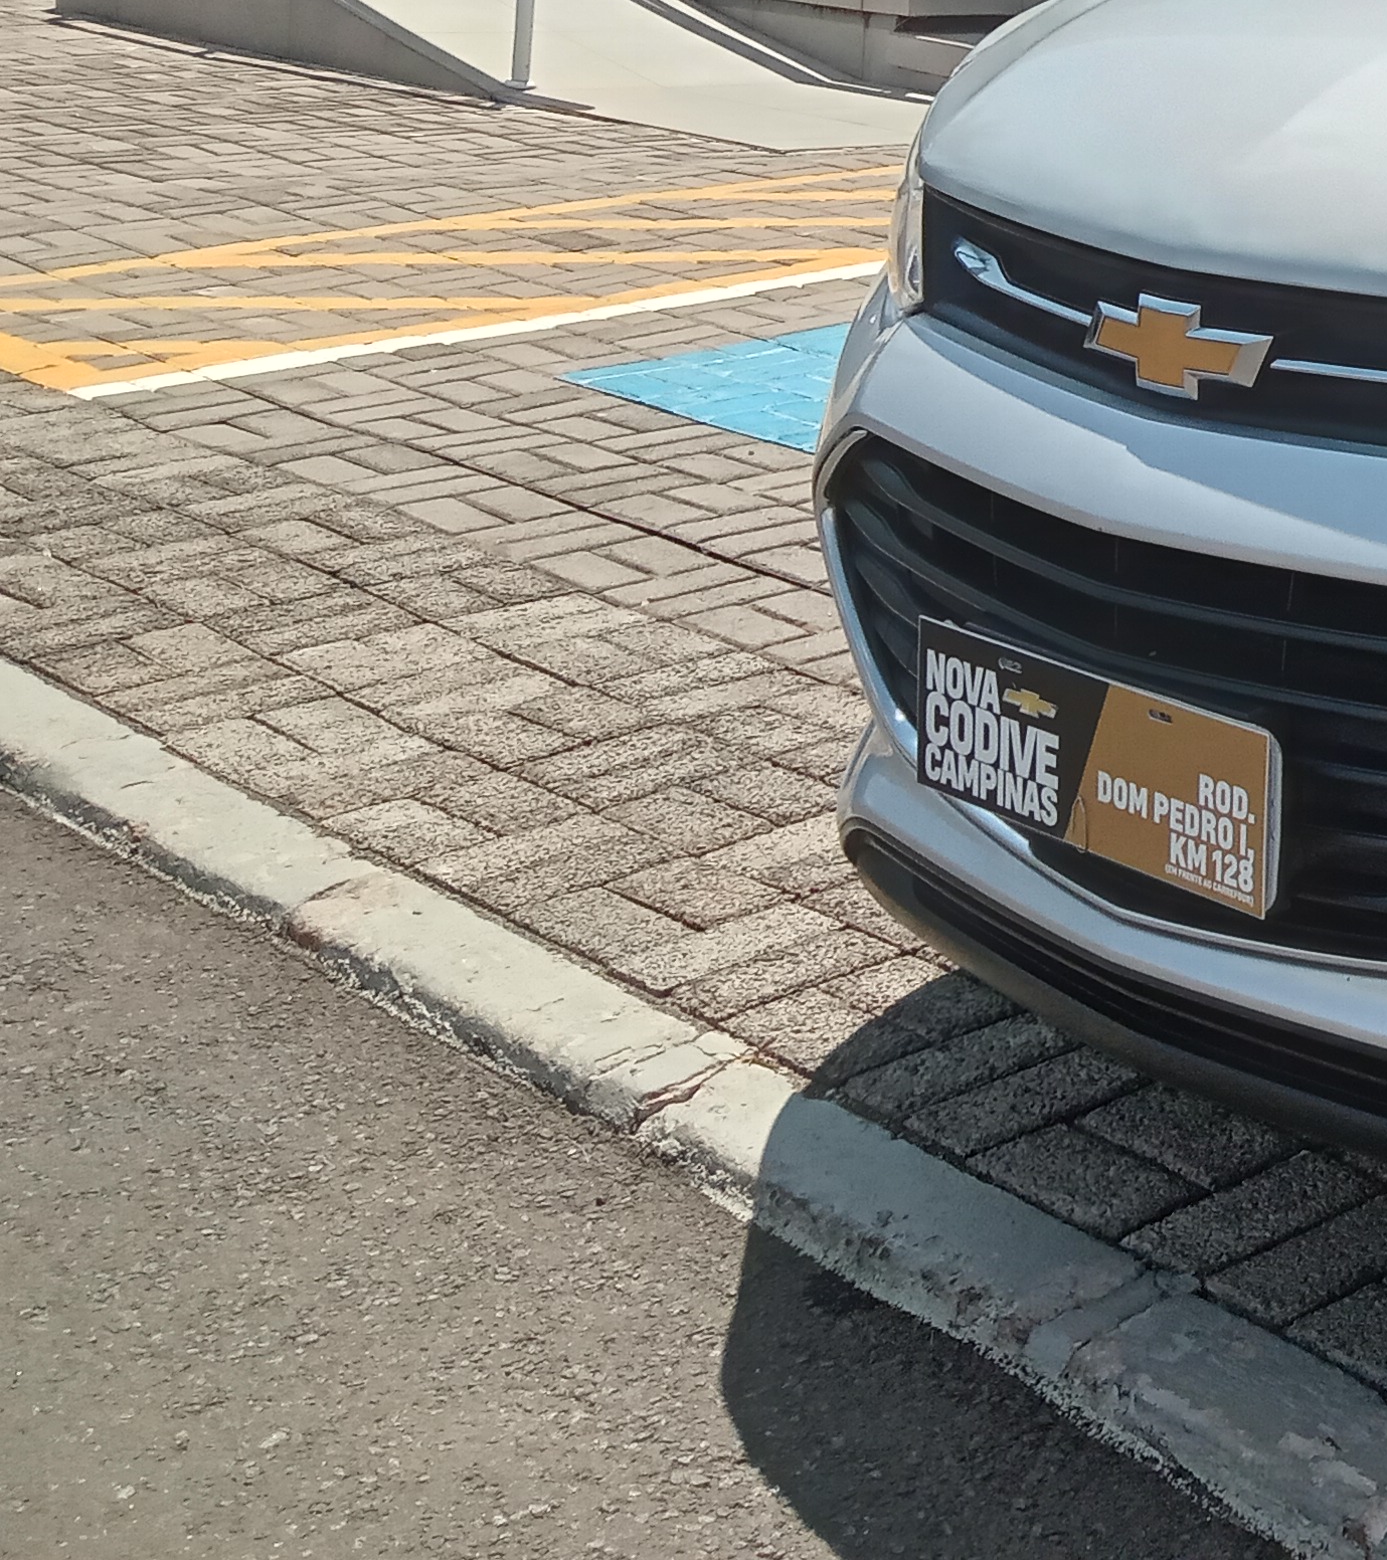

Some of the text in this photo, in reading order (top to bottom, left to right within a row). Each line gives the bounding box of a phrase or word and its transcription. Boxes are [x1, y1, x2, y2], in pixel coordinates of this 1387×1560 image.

[926, 648, 1001, 715] NOVA
[925, 691, 1060, 791] CODIVE
[924, 743, 1059, 827] CAMPINAS
[1097, 770, 1149, 820] DOM
[1153, 791, 1234, 850] PEDRO
[1198, 773, 1256, 825] ROD.
[1169, 832, 1254, 893] KM 128
